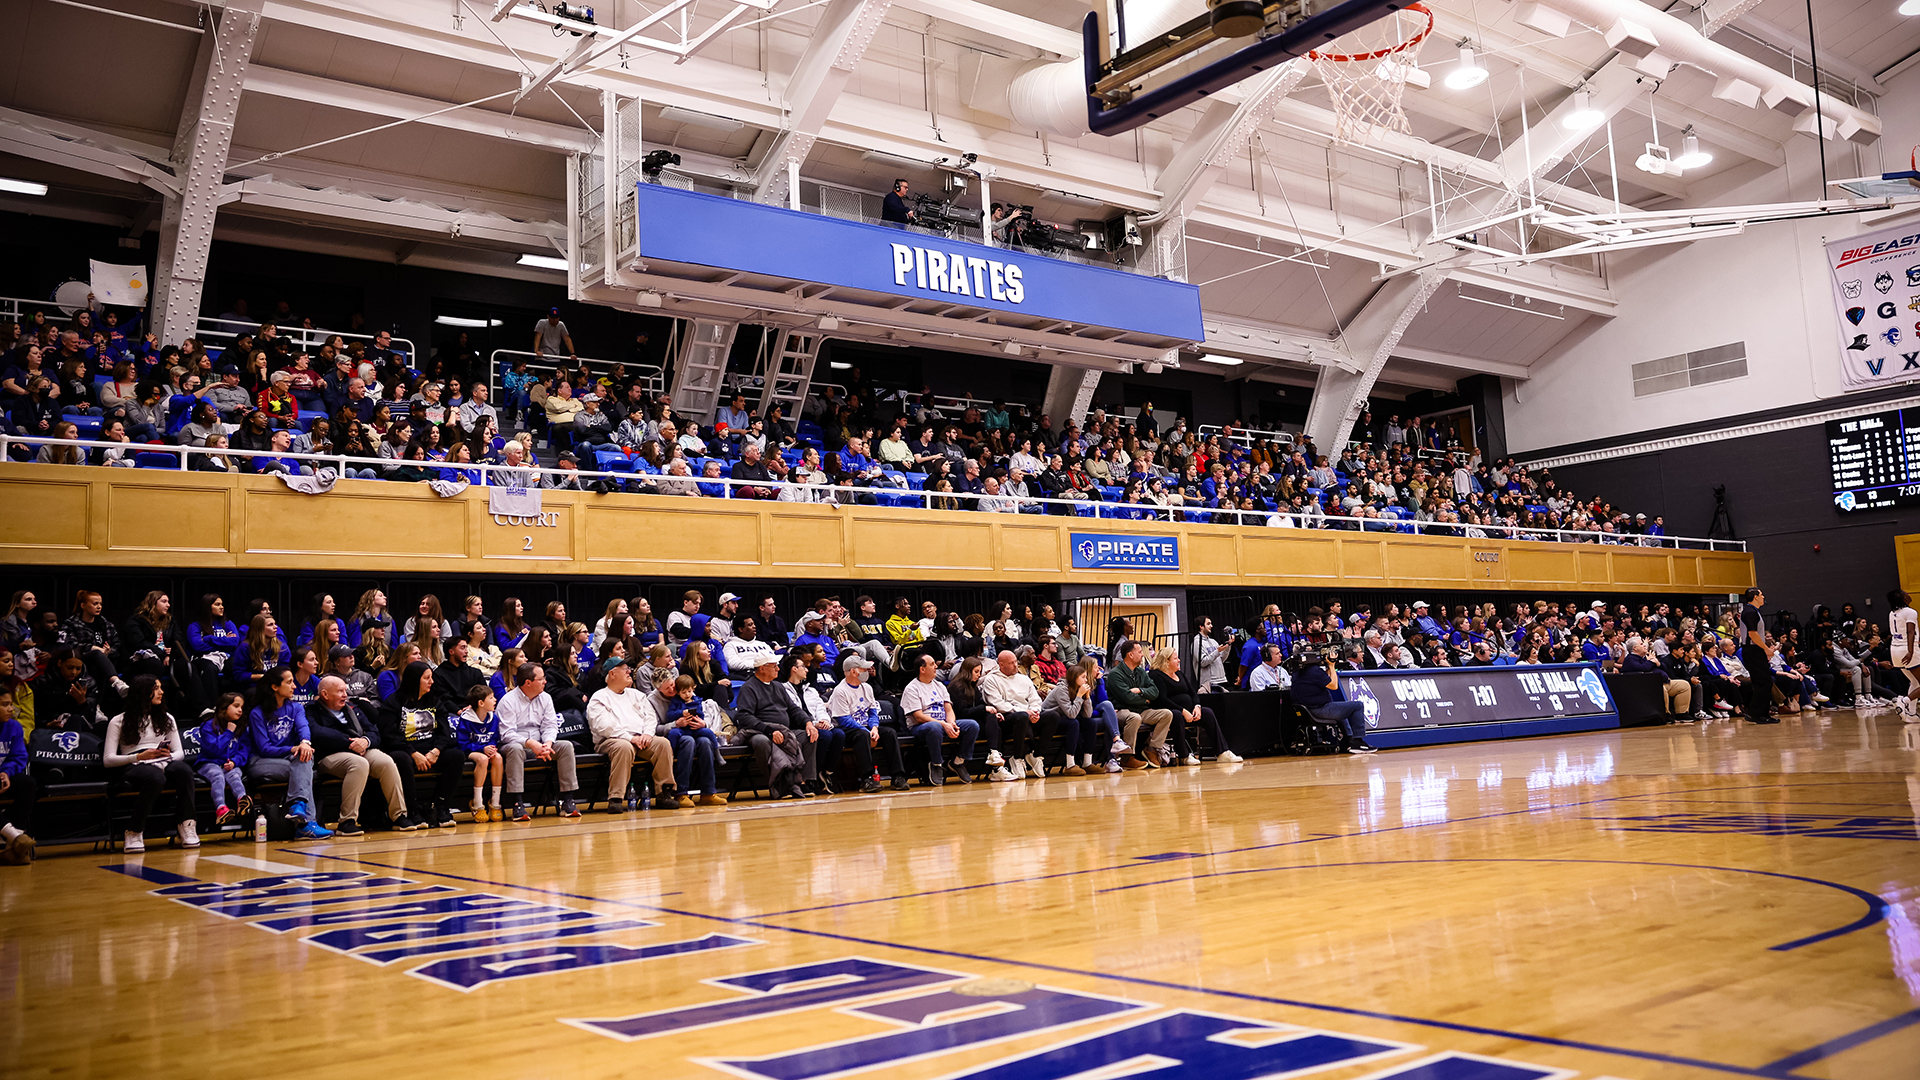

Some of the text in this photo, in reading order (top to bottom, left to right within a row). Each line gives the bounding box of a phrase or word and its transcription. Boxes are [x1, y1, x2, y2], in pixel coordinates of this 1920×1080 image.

[1840, 245, 1873, 261] BIG
[1870, 250, 1916, 264] CONFERENCE
[890, 242, 1025, 304] PIRATES
[1878, 302, 1897, 319] G
[1866, 351, 1920, 376] V X
[1840, 418, 1884, 433] THE HALL
[1867, 490, 1877, 500] 13
[1898, 486, 1920, 496] 7:07
[494, 512, 560, 527] COURT
[523, 536, 534, 550] 2
[1097, 541, 1173, 556] PIRATE
[1474, 552, 1499, 562] COURT
[1486, 567, 1490, 577] 1
[1124, 584, 1134, 596] EXIT
[1894, 619, 1897, 632] 1
[1391, 679, 1442, 702] UCONN
[1516, 672, 1578, 694] THE HALL
[1469, 685, 1497, 706] 7:07
[1548, 694, 1564, 711] 13
[565, 724, 584, 733] BLUE
[36, 750, 72, 760] PIRATE
[147, 870, 768, 993] PIRATES
